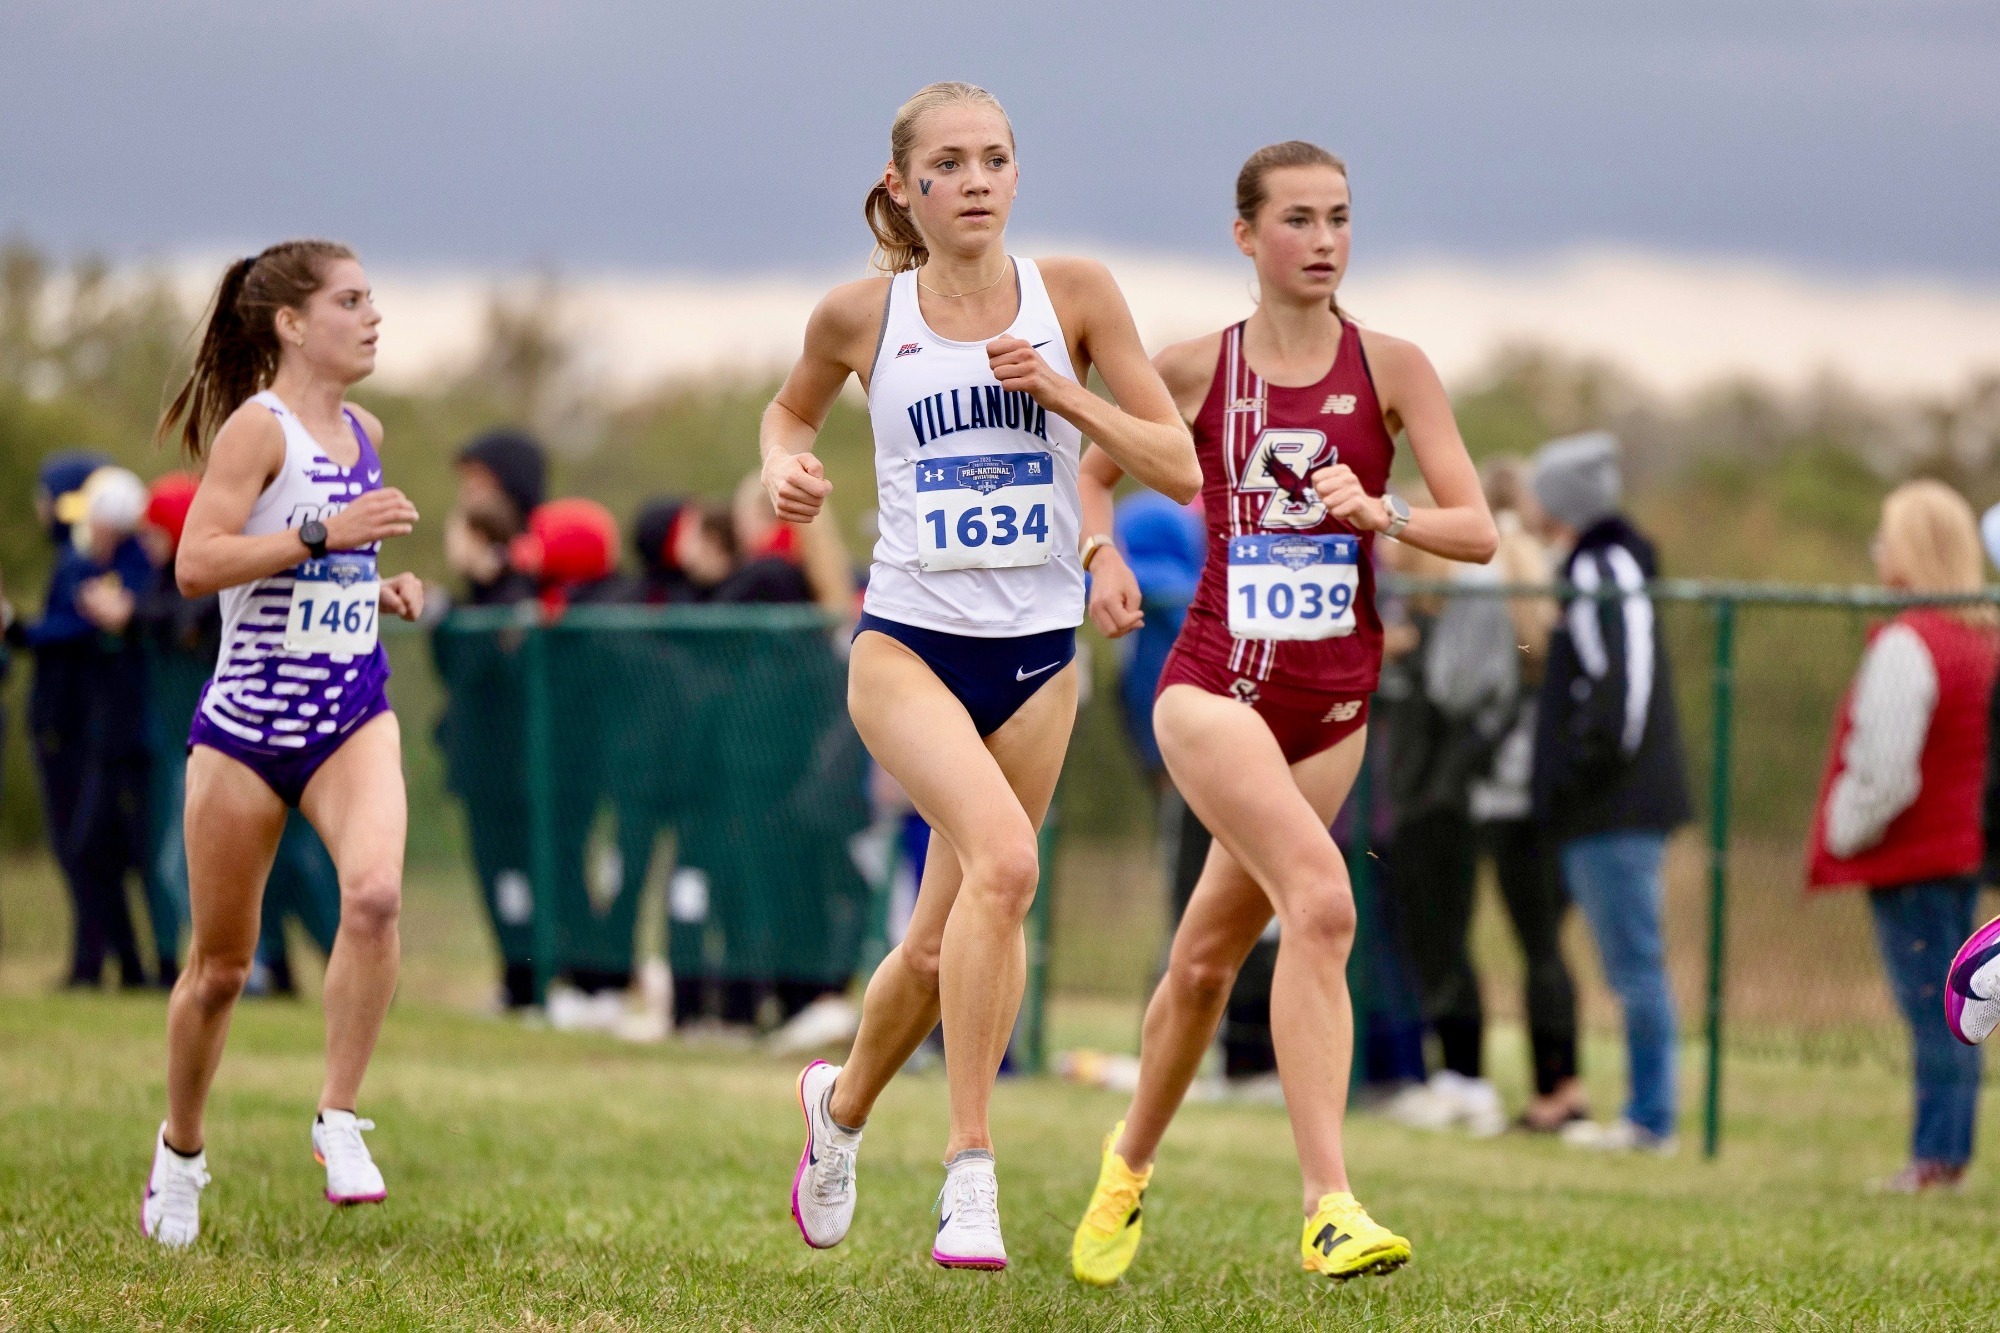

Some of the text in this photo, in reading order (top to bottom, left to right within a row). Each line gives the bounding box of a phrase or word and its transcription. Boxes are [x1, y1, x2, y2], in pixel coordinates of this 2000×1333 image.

[918, 178, 933, 196] V
[897, 347, 922, 355] EAST
[907, 385, 1047, 447] VILLANOVA
[962, 467, 1010, 477] PRE-NATIONAL
[925, 504, 1048, 549] 1634
[298, 601, 376, 634] 1467
[1238, 583, 1351, 620] 1039
[1312, 1223, 1352, 1257] N
